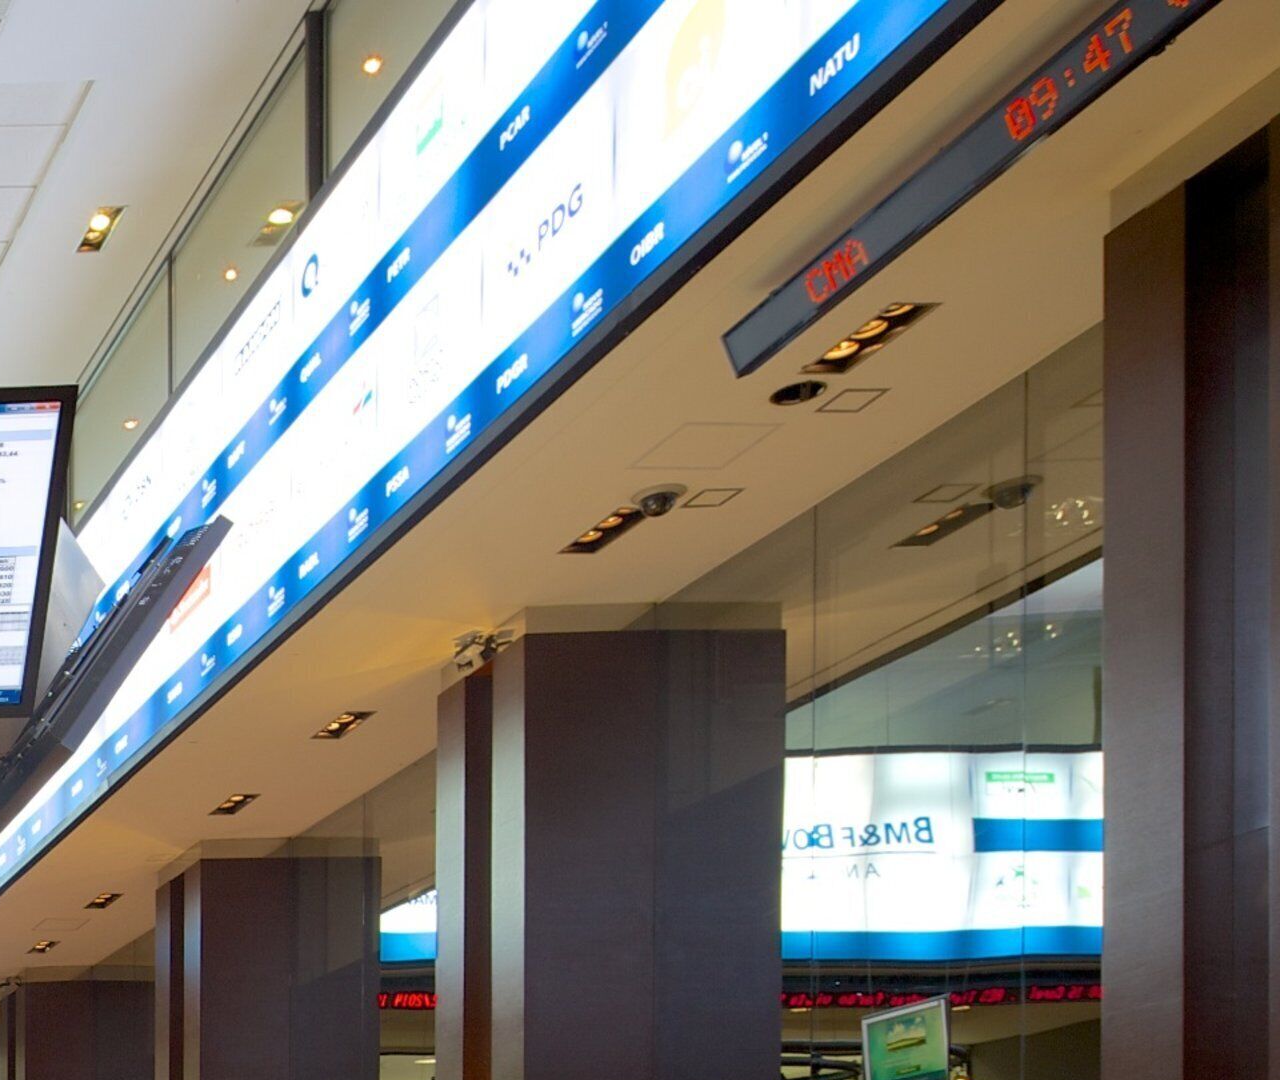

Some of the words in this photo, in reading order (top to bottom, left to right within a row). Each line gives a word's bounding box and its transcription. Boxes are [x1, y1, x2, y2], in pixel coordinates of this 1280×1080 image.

[809, 33, 860, 96] NATU
[500, 105, 530, 151] PCAR
[538, 183, 583, 251] PDG
[629, 222, 665, 267] OIBR
[804, 238, 870, 303] CMA
